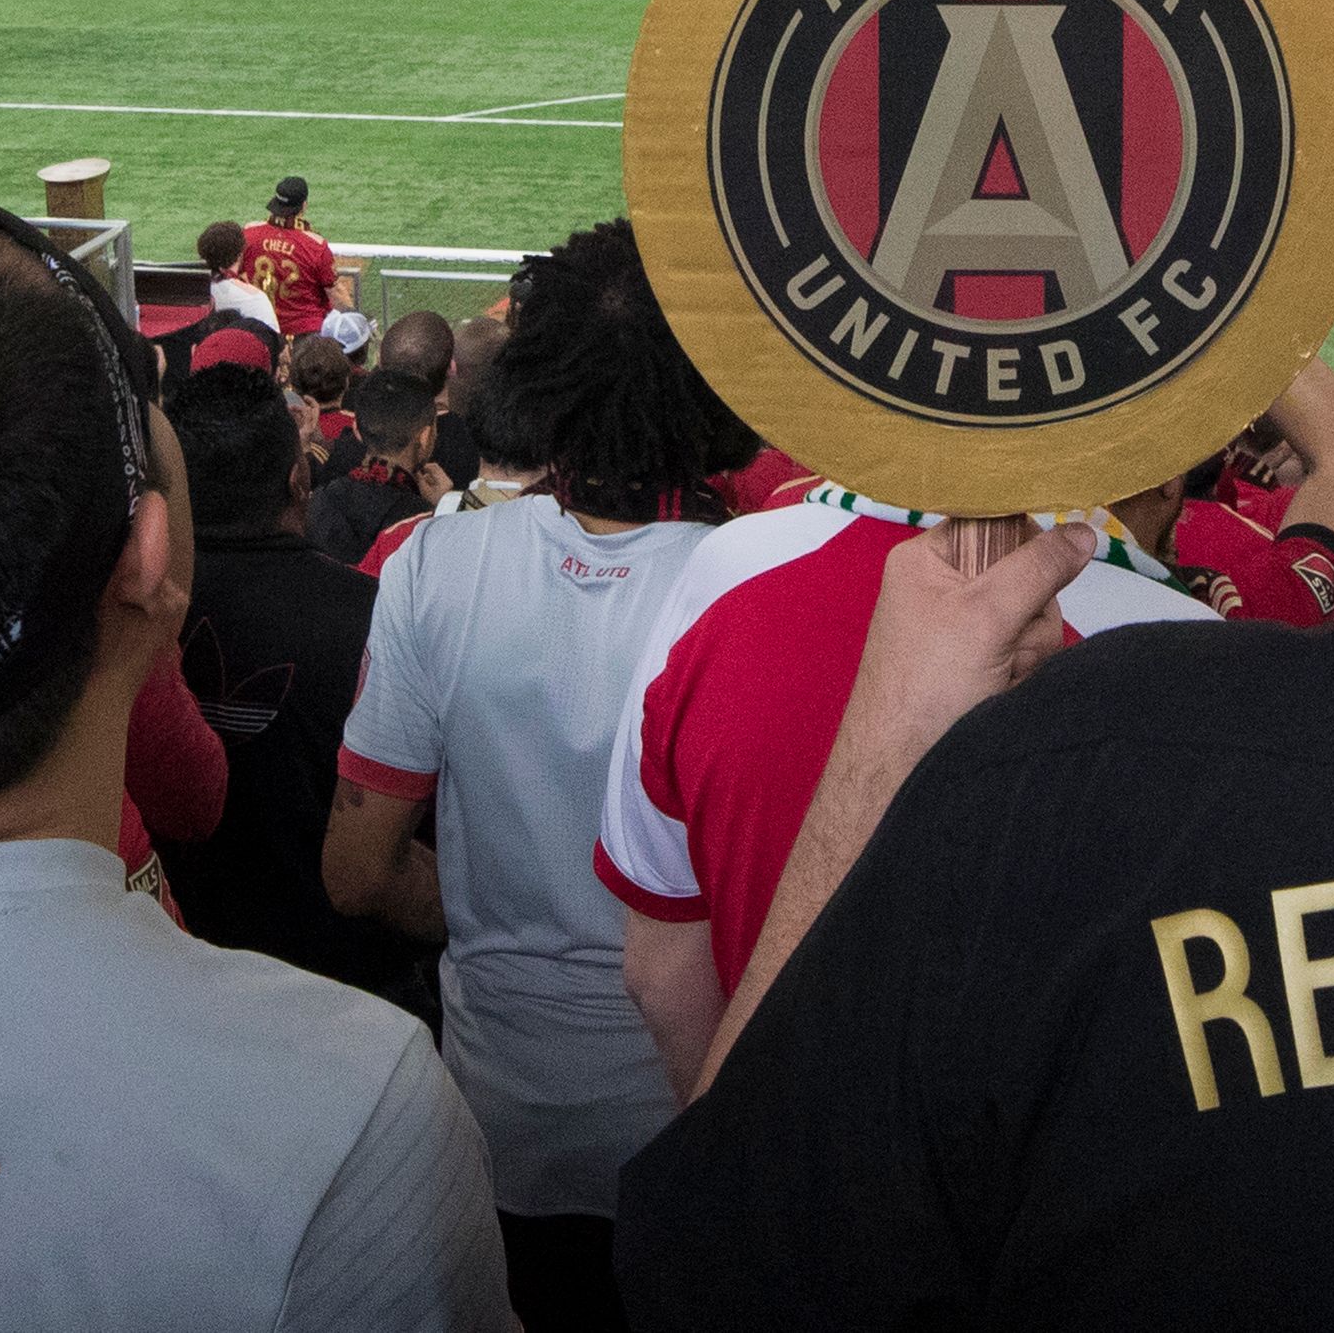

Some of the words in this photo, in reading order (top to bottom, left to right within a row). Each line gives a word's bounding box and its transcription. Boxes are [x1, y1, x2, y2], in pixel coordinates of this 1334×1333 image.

[785, 253, 1088, 402] UNITED
[1118, 257, 1219, 358] FC
[560, 555, 590, 578] ATL
[1311, 577, 1331, 607] MLS
